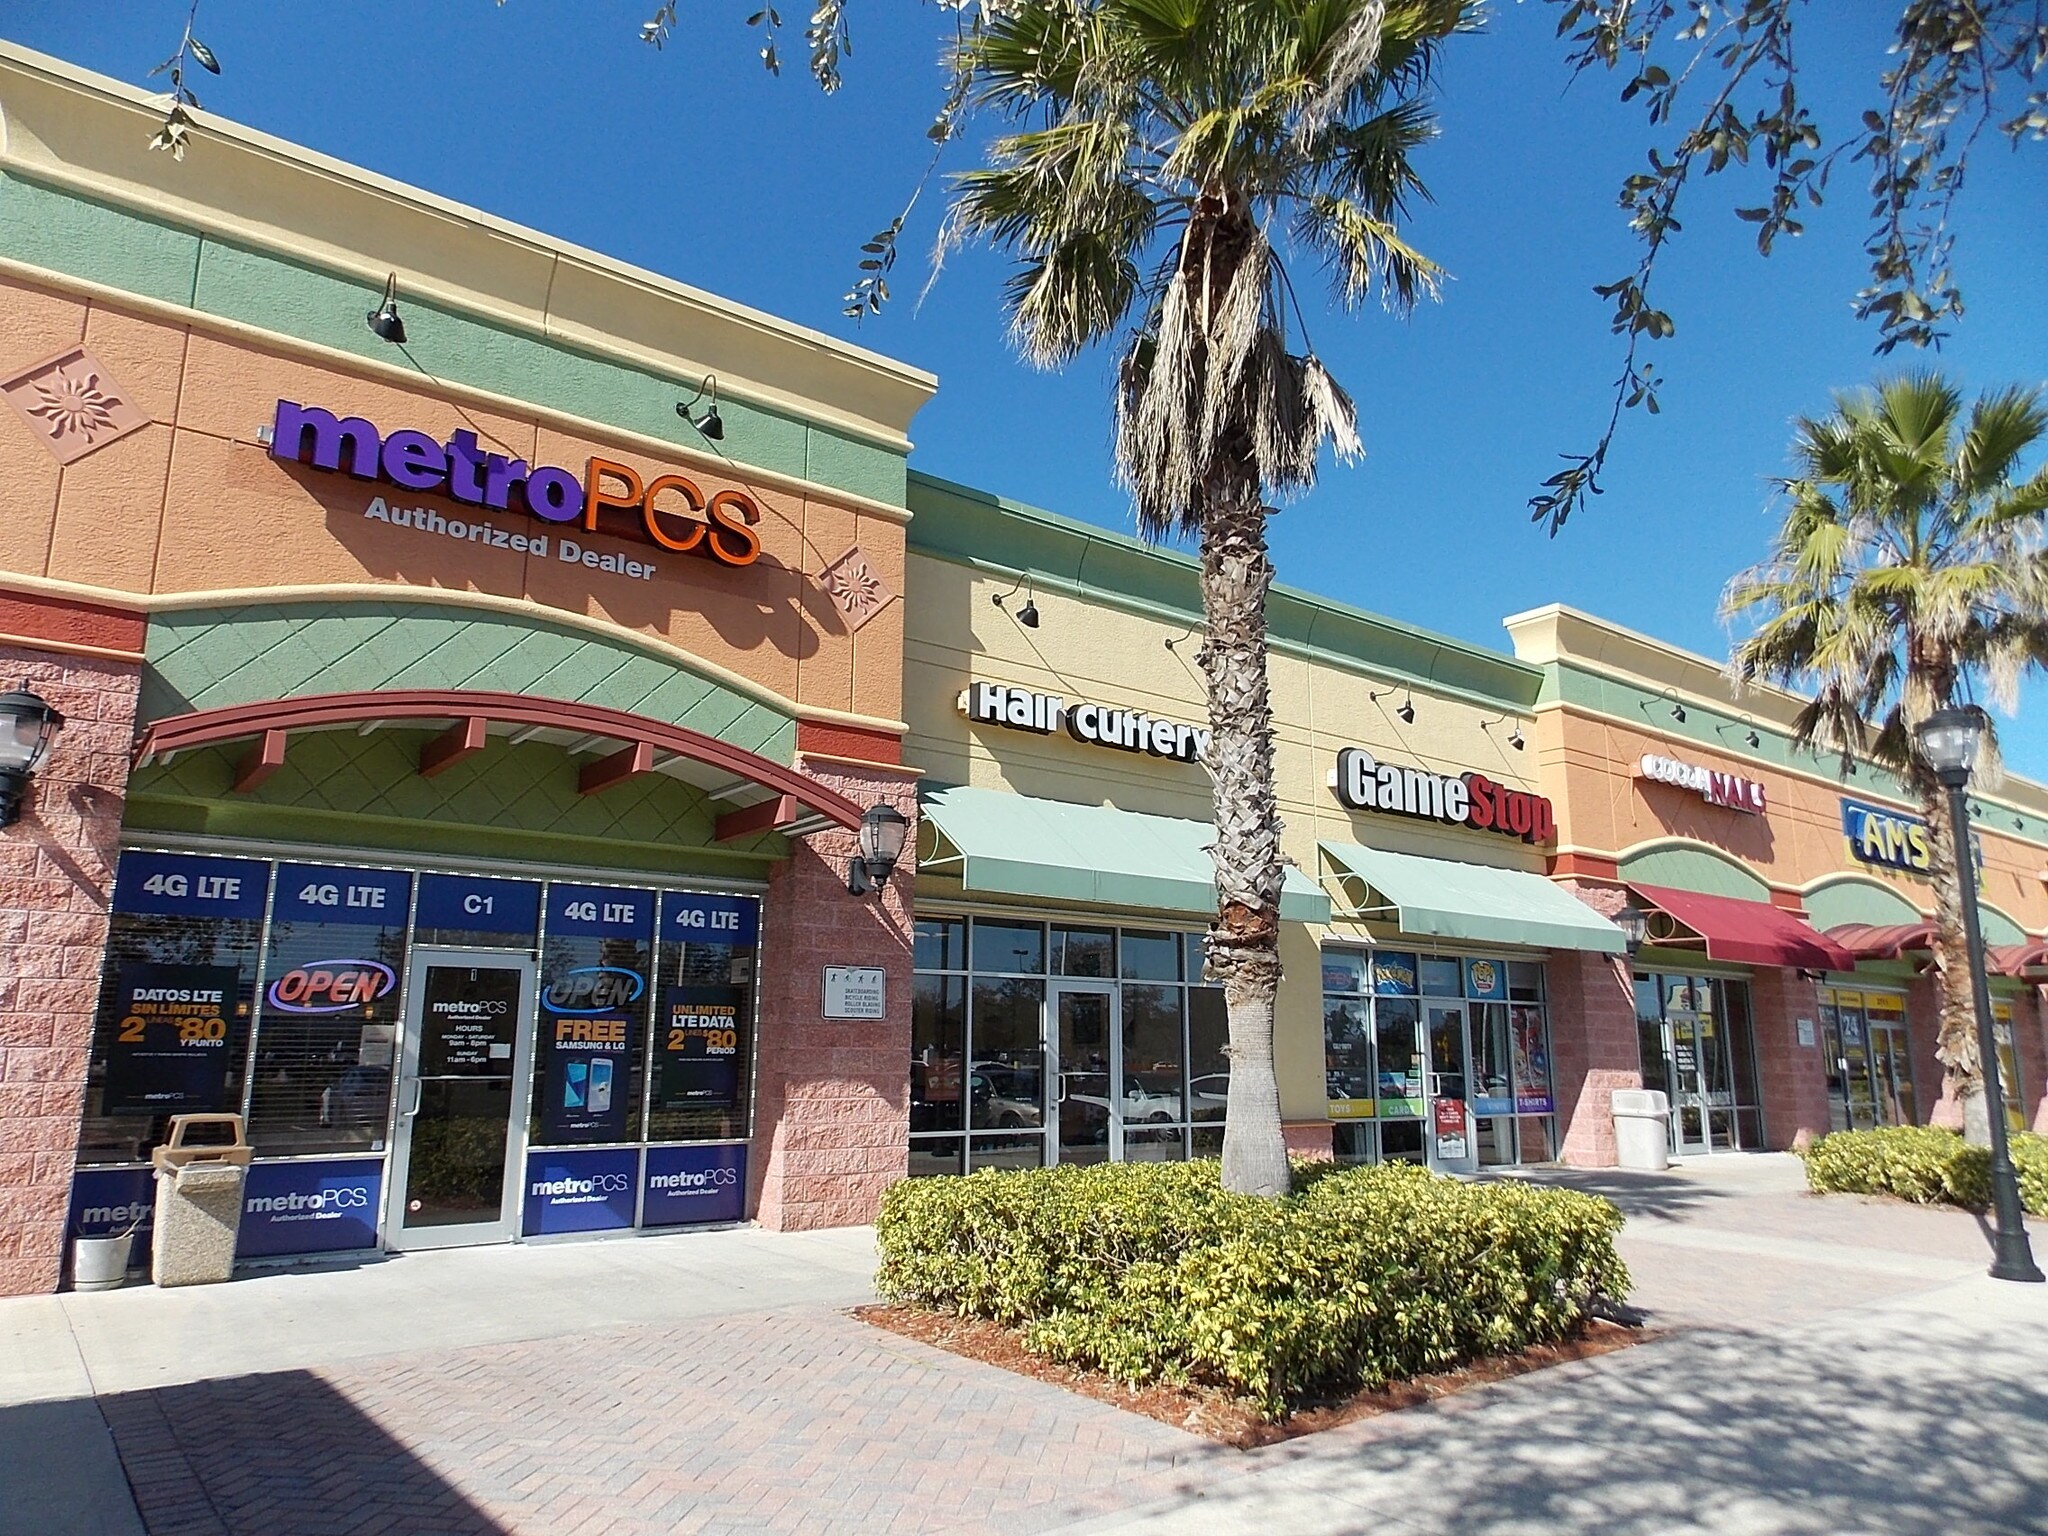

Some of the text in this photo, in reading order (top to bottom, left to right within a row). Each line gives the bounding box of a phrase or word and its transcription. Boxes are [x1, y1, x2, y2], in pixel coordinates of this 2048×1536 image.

[269, 398, 761, 567] metroPCS
[364, 497, 656, 580] Authorized Dealer
[972, 682, 1063, 733] Hair
[1341, 747, 1555, 843] GameStop
[1864, 813, 1930, 869] AMS
[143, 874, 241, 900] 4G LTE
[298, 885, 386, 908] 4G LTE
[463, 895, 494, 915] C1
[564, 903, 635, 924] 4G LTE
[676, 910, 739, 930] 4G LTE
[132, 988, 223, 1003] DATOS LTE
[276, 970, 383, 1003] OPEN
[549, 976, 634, 1006] OPEN
[130, 1003, 158, 1014] SIN
[432, 1001, 507, 1014] metroPCS
[672, 1004, 736, 1016] UNLIMITED
[118, 1016, 146, 1042] 2
[556, 1019, 627, 1041] FREE
[671, 1015, 735, 1028] LTE DATA
[180, 1039, 224, 1047] Y PUNTO
[555, 1041, 625, 1050] SAMSUNG & LG
[667, 1029, 685, 1050] 2
[706, 1047, 736, 1055] PERIOD
[1329, 1104, 1351, 1113] TOYS
[1518, 1098, 1547, 1107] T-SHIRTS
[531, 1174, 628, 1196] metroPCS
[649, 1168, 737, 1189] metroPCS
[246, 1187, 368, 1213] metroPCS
[270, 1211, 342, 1223] Authorized Dealer
